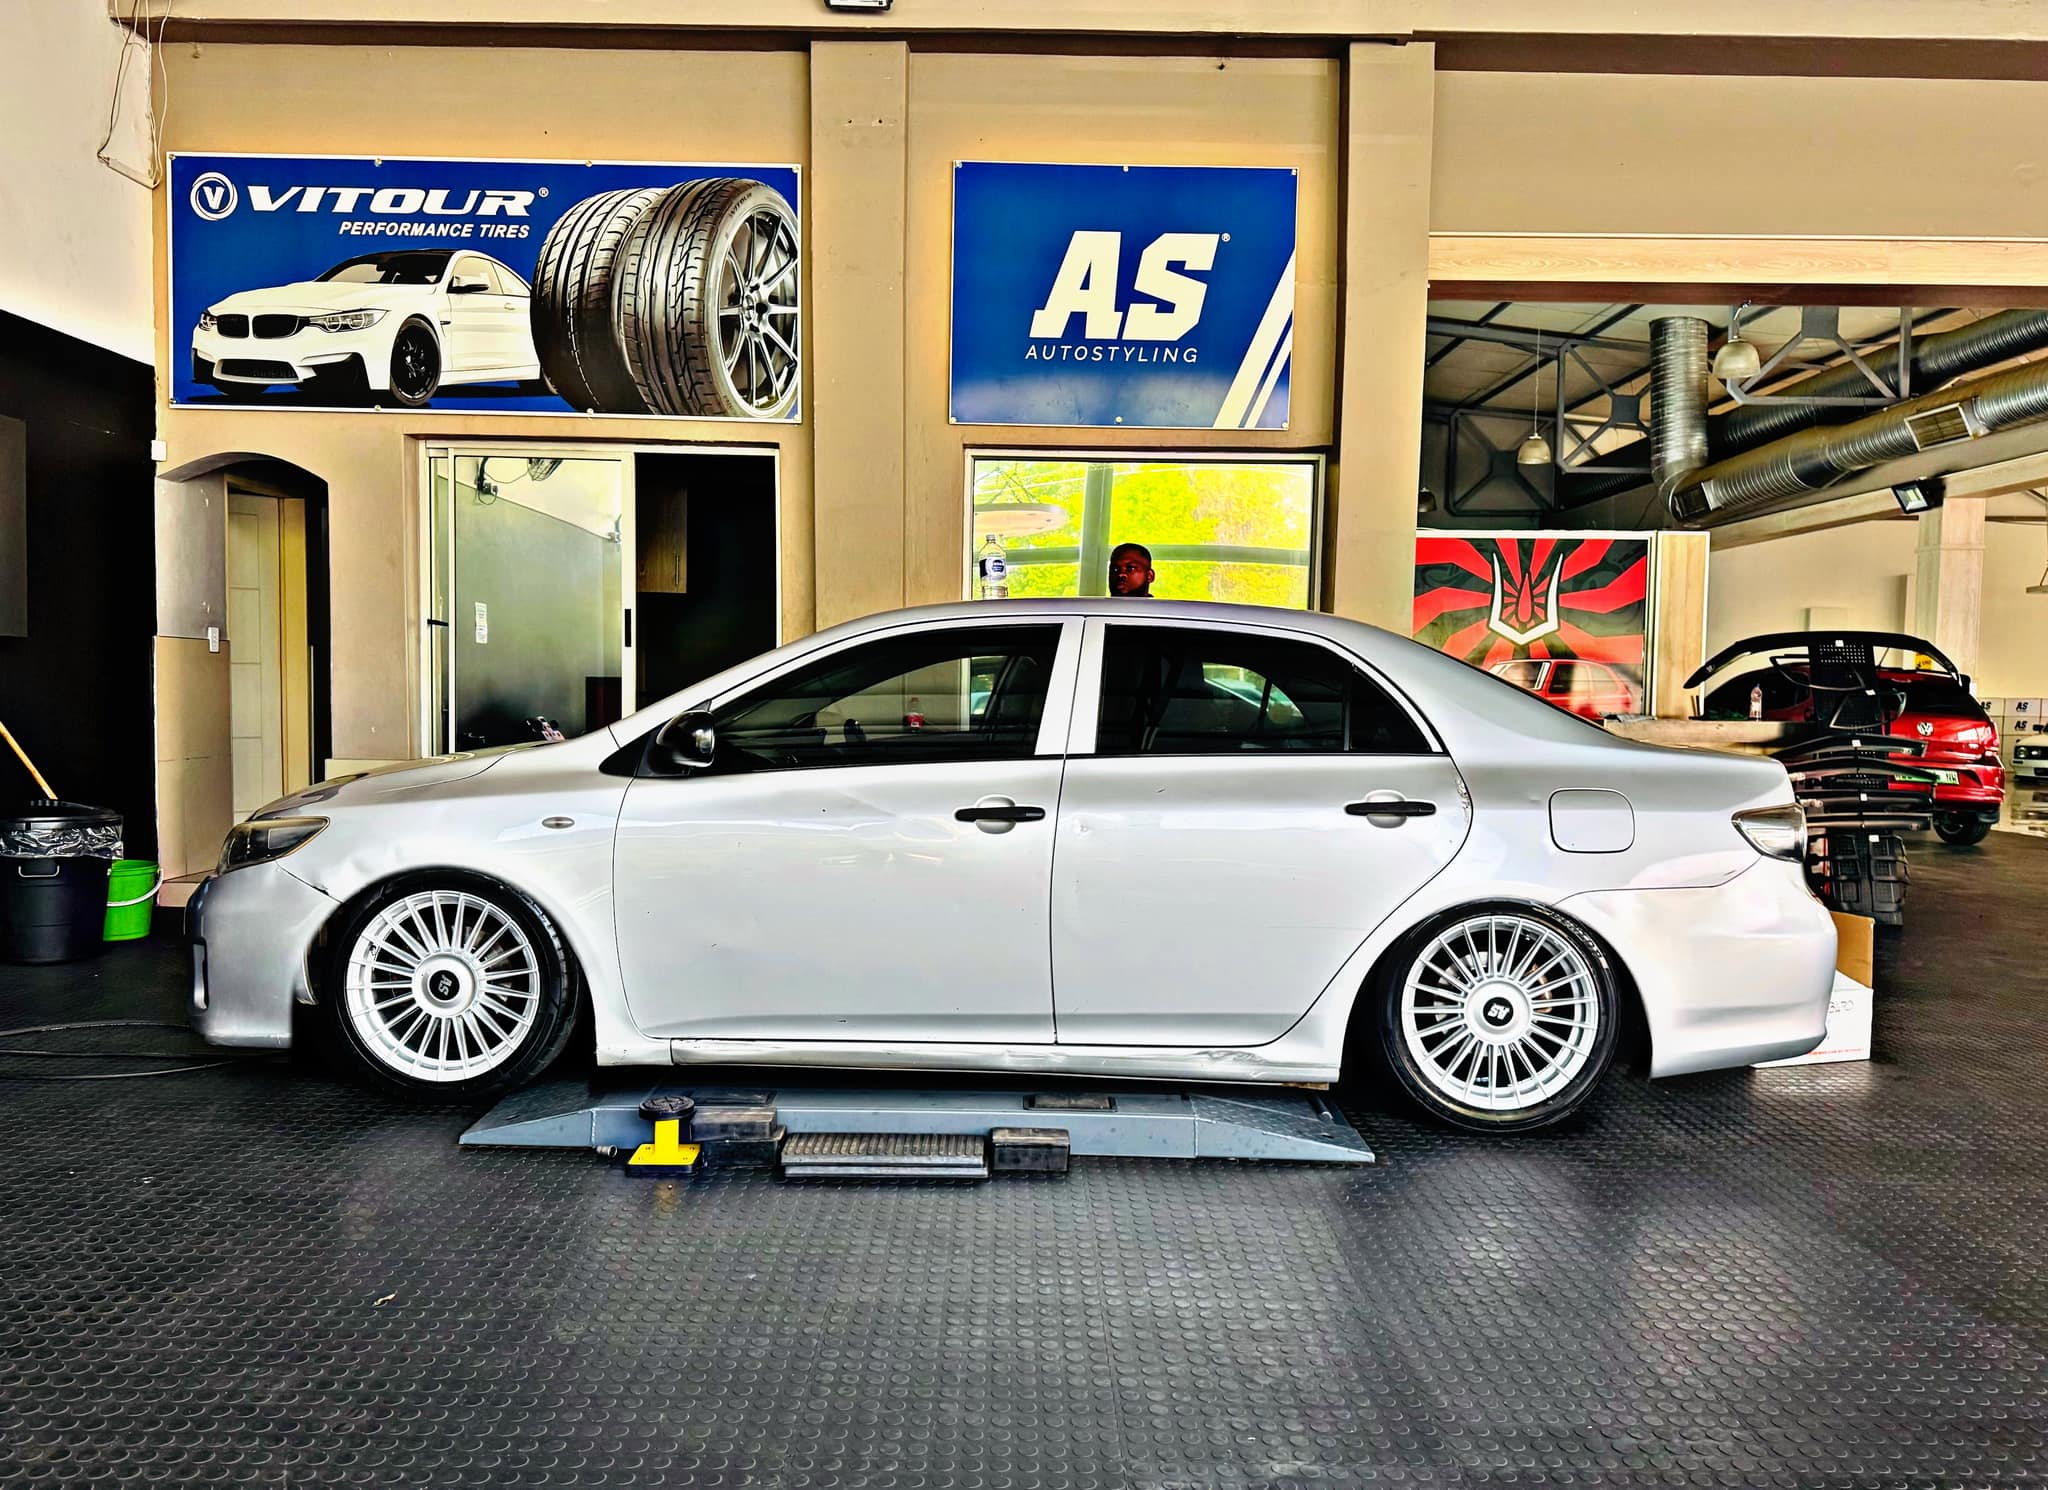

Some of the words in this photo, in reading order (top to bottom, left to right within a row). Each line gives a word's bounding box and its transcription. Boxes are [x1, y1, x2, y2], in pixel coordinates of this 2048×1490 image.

[247, 185, 535, 216] VITOUR
[338, 221, 474, 238] PERFORMANCE
[480, 223, 531, 239] TIRES
[1028, 230, 1220, 341] AS
[1024, 344, 1199, 364] AUTOSTYLING
[2016, 702, 2029, 711] AS
[2014, 721, 2027, 730] AS
